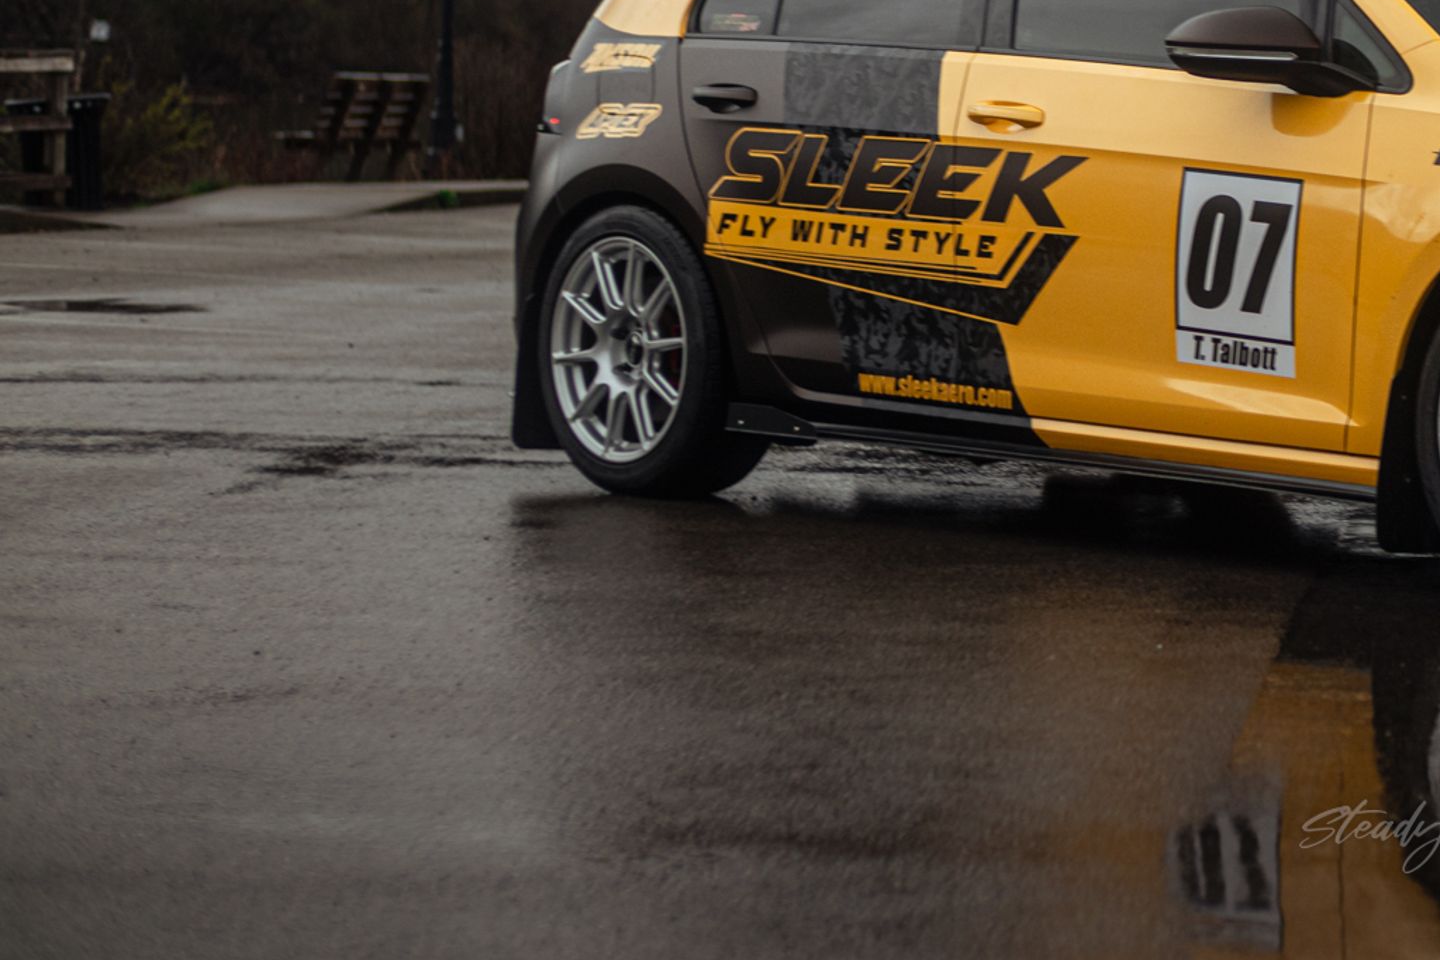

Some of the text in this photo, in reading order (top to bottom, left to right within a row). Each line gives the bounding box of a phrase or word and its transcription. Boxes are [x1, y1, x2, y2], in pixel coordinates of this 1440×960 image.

[708, 126, 1090, 228] SLEEK
[717, 212, 998, 259] FLY WITH STYLE
[1186, 194, 1293, 314] 07
[1193, 335, 1278, 371] T. Talbott
[858, 372, 1013, 410] www.sleekaero.com
